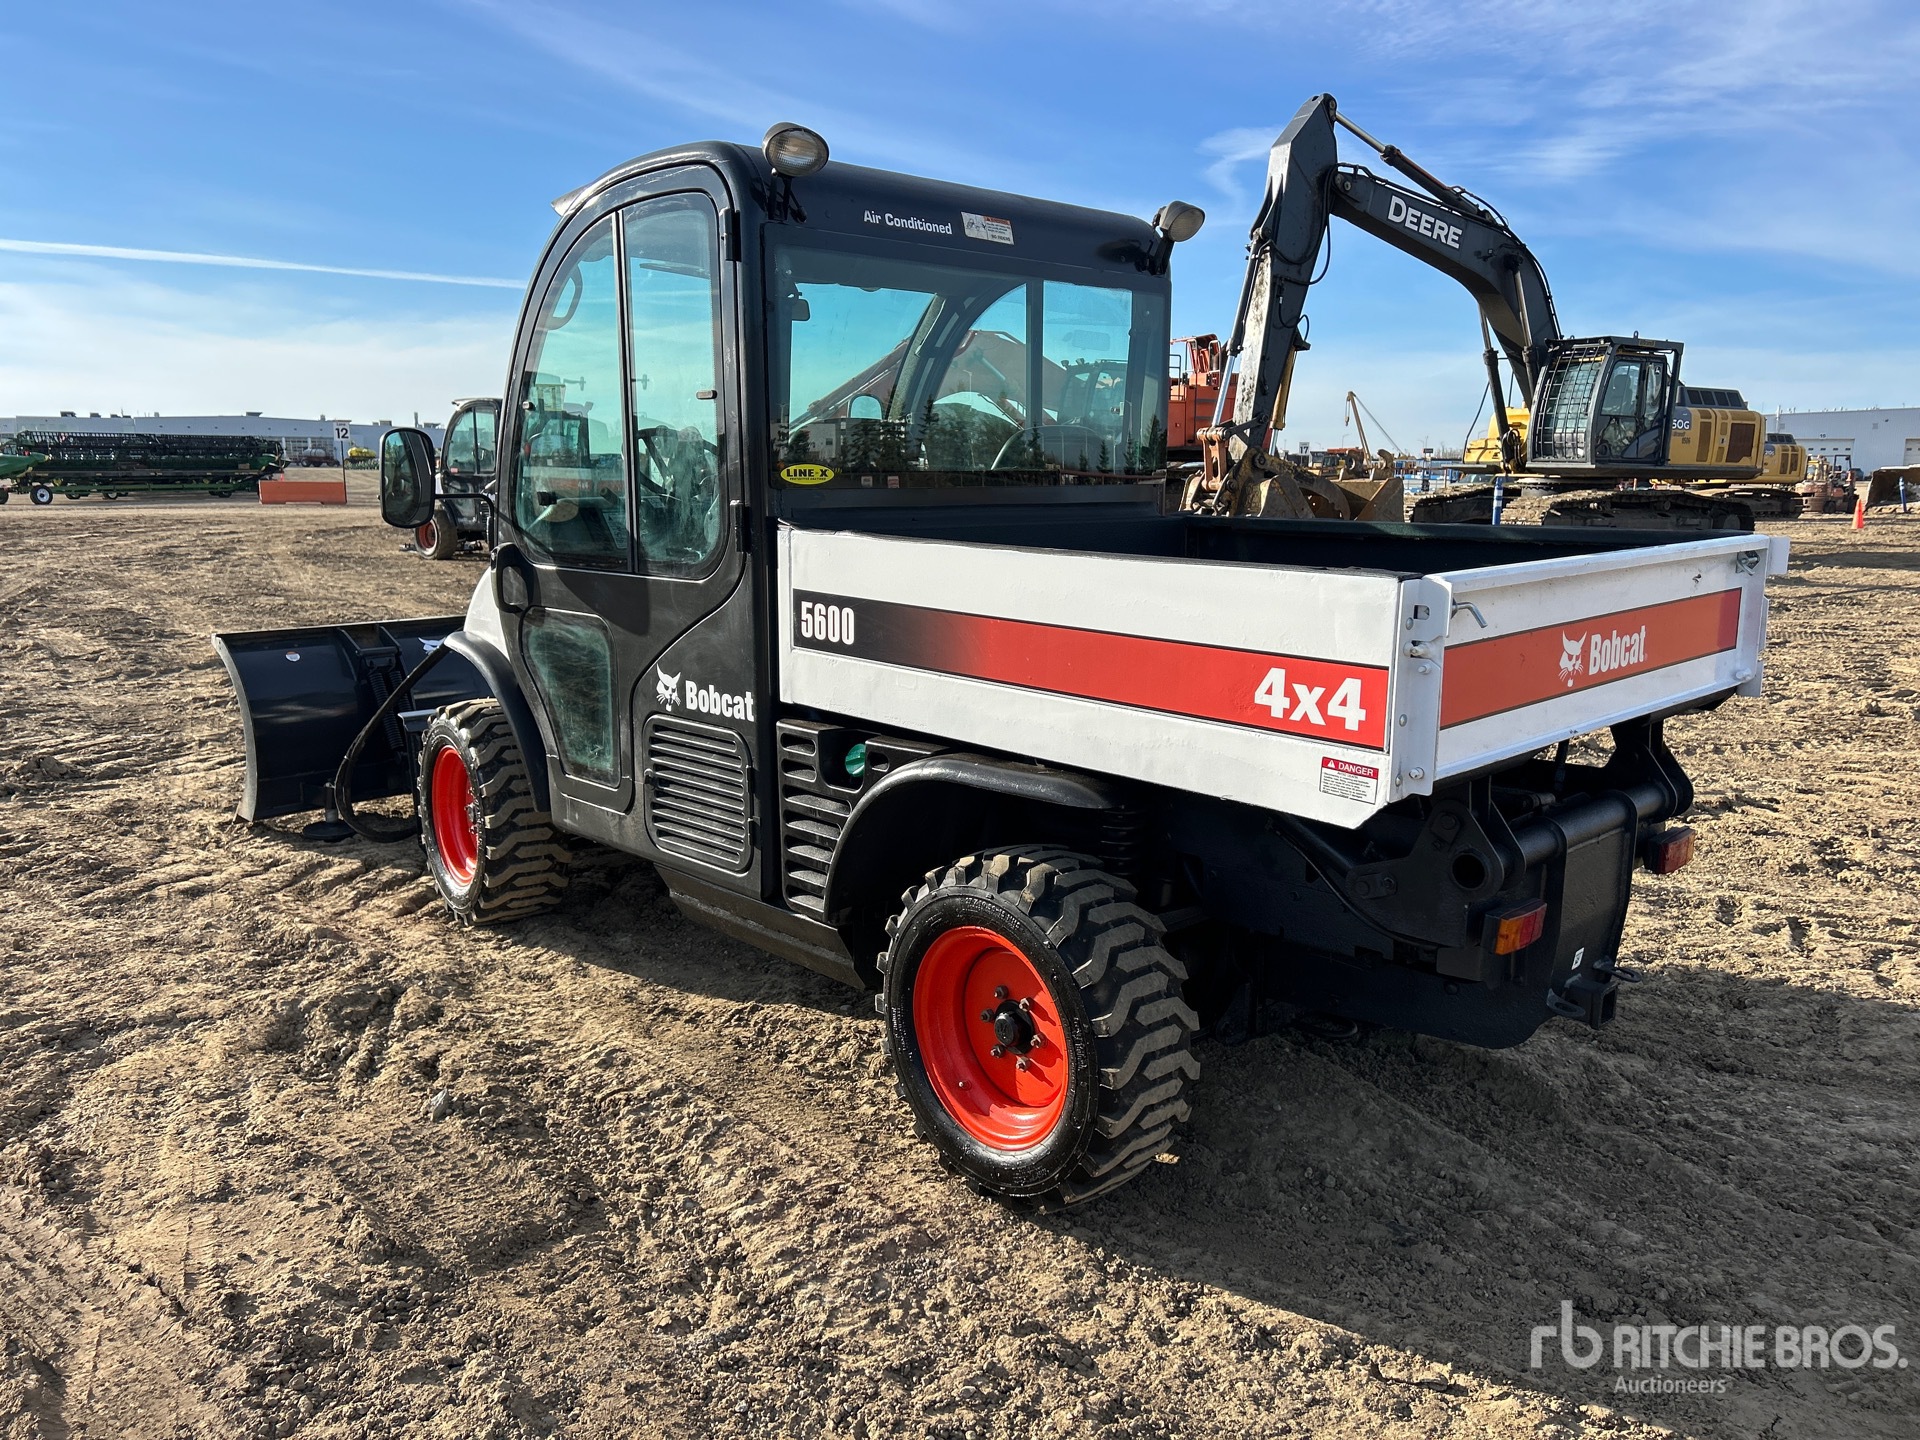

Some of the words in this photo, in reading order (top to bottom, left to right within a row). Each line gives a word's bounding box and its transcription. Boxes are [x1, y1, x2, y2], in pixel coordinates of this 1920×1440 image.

[863, 210, 881, 224] Air
[884, 213, 953, 235] Conditioned
[1388, 195, 1462, 249] DEERE
[335, 427, 349, 439] 12
[1299, 446, 1309, 454] 17
[786, 468, 829, 478] LINE-X
[801, 601, 855, 645] 5600
[1588, 625, 1646, 676] Bobcat
[685, 680, 754, 722] Bobcat
[1254, 667, 1366, 731] 4x4
[1338, 761, 1374, 777] DANGER
